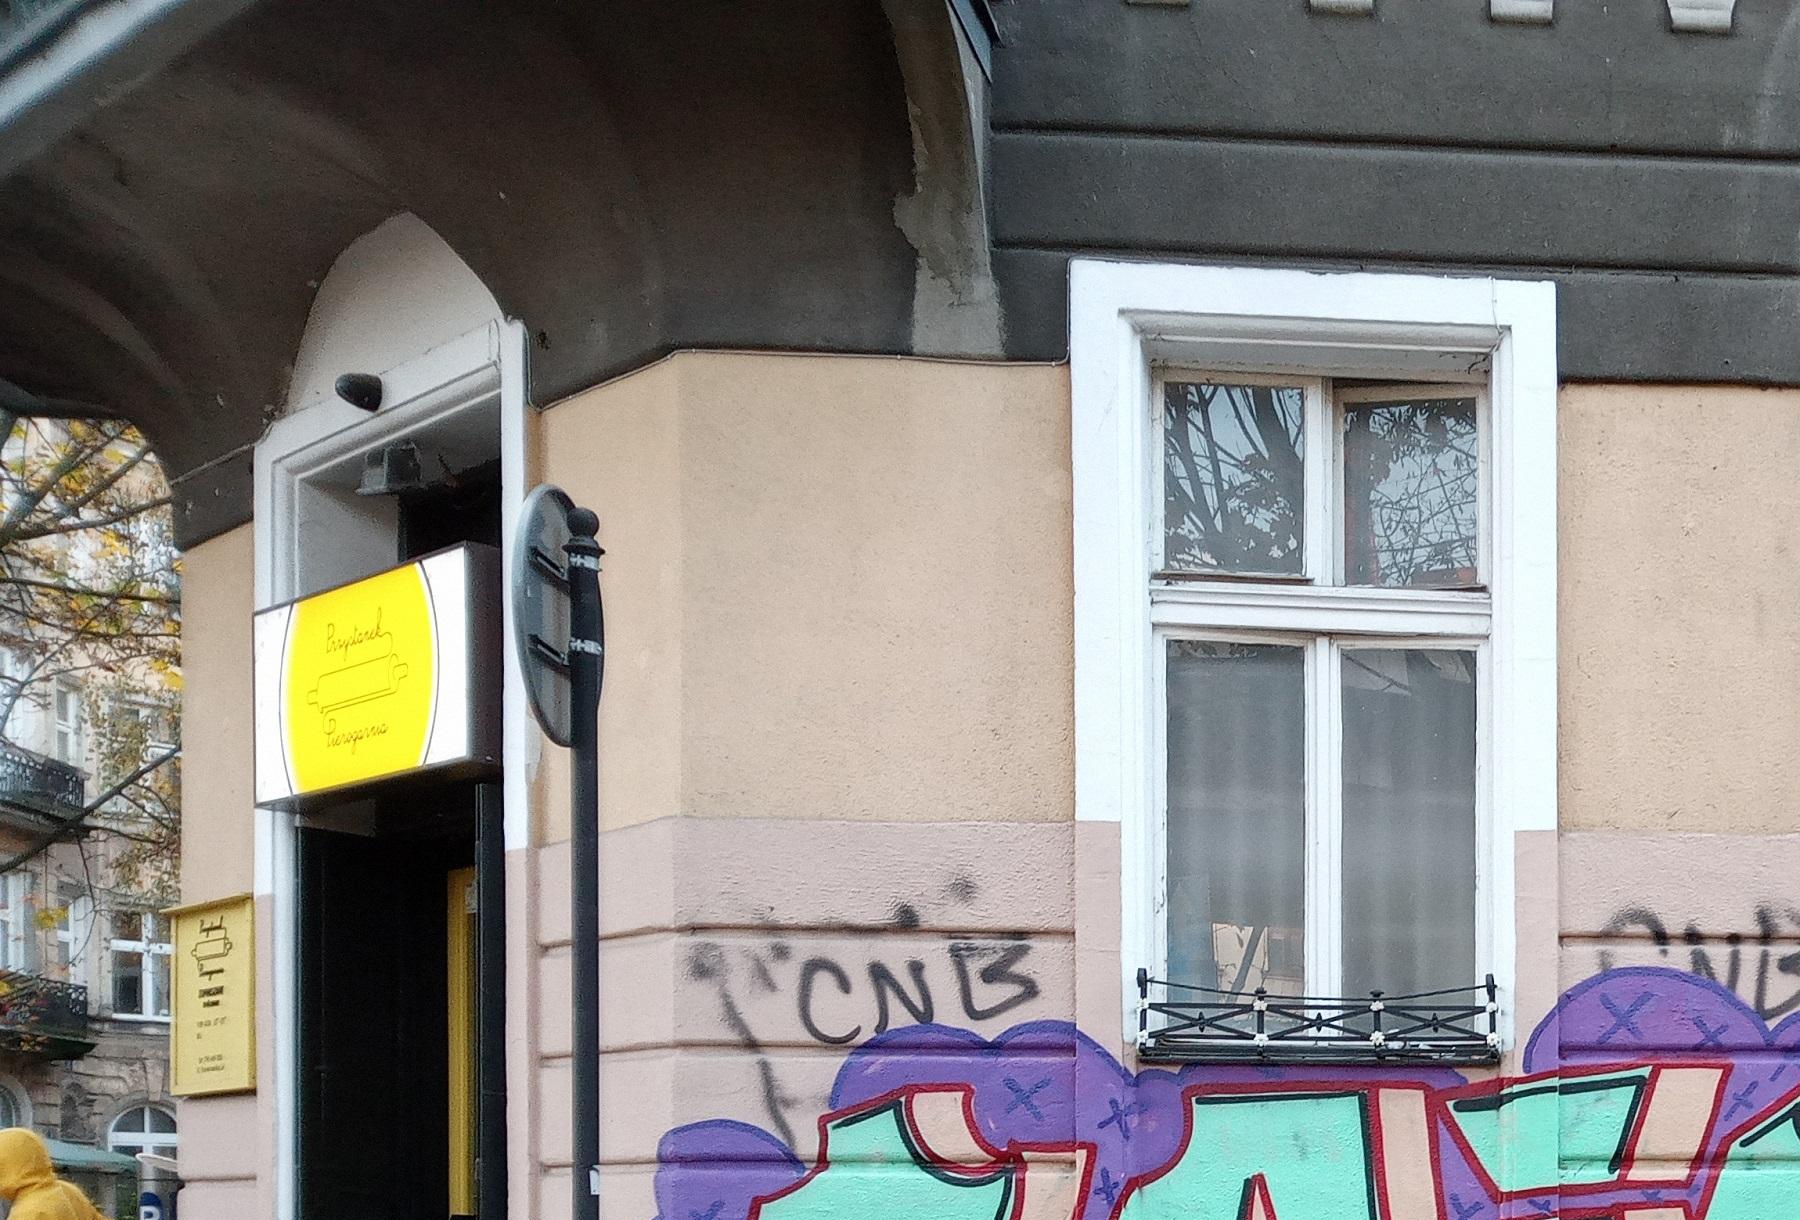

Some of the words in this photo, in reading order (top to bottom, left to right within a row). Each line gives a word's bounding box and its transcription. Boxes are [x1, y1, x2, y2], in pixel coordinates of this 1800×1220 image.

[325, 606, 384, 661] Przystanek
[324, 718, 389, 755] Pierogarnia
[797, 934, 1041, 1044] CNB
